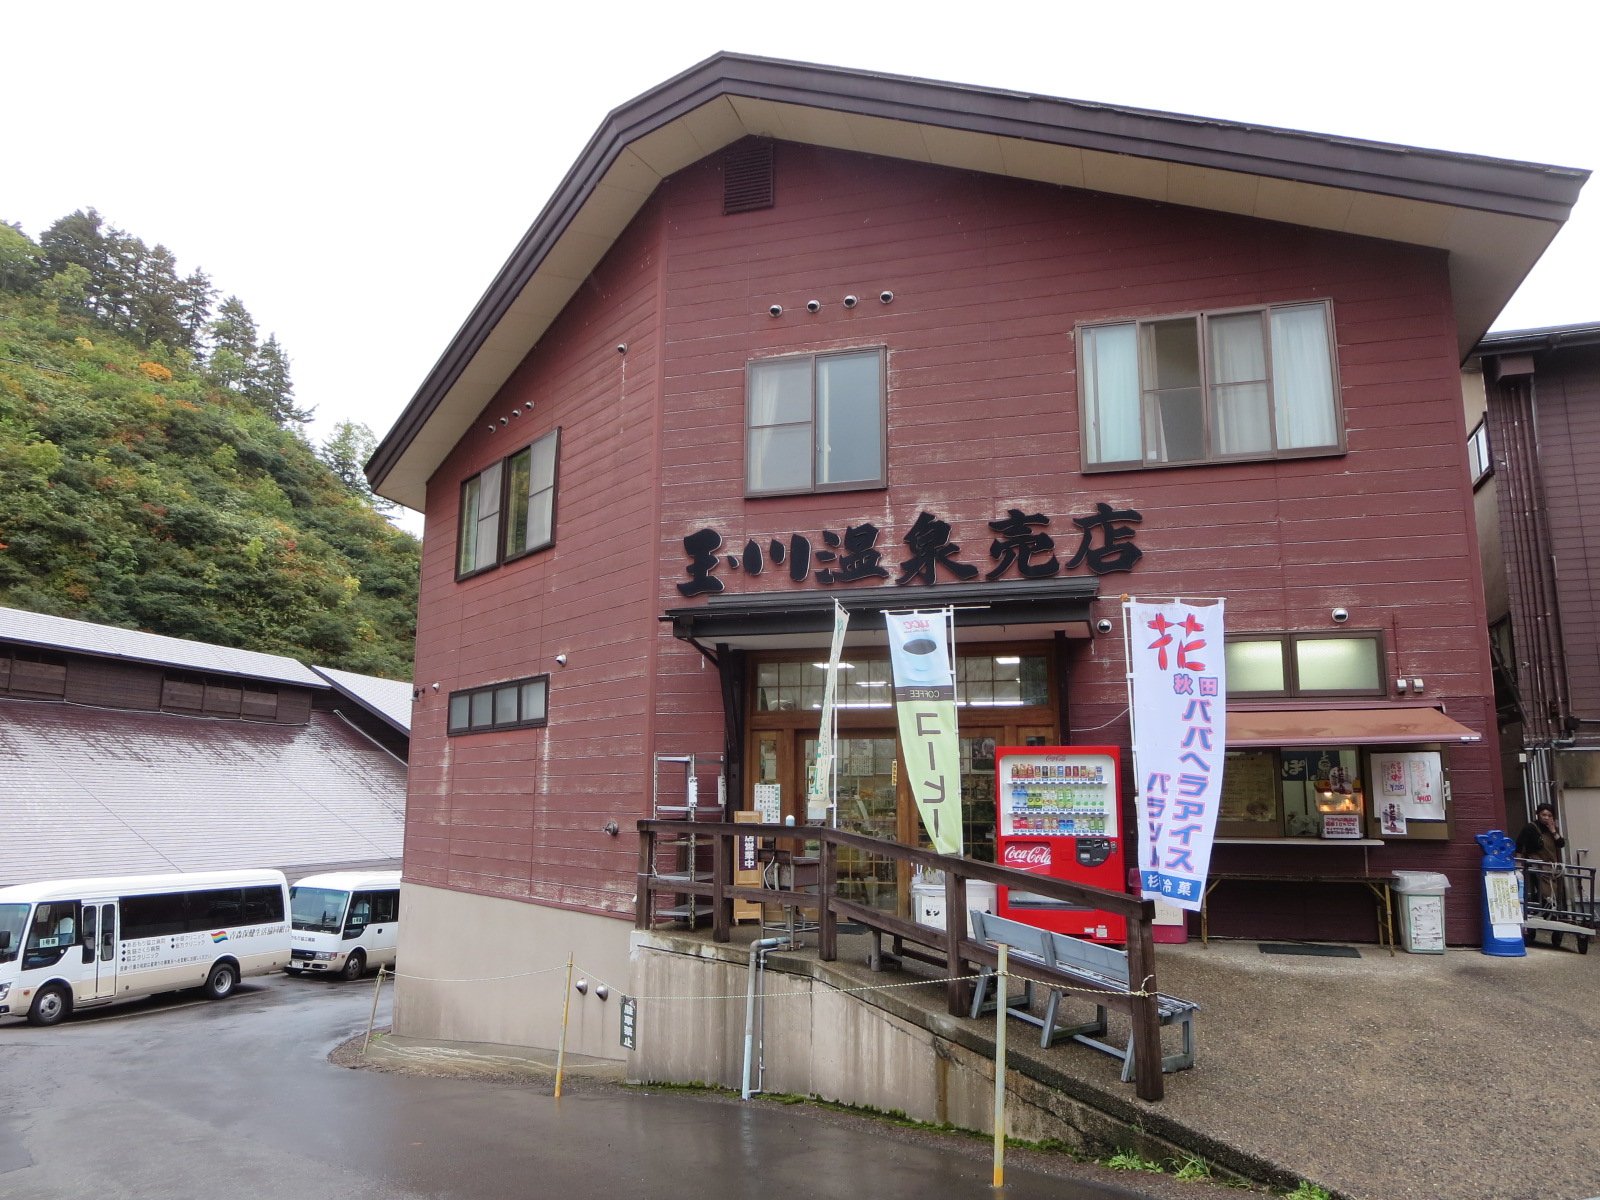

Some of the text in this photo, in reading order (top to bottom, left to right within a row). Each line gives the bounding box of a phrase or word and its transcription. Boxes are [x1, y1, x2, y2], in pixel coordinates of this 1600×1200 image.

[677, 503, 1143, 597] 玉川温泉売店
[1147, 613, 1206, 671] 花
[1173, 673, 1219, 696] 秋田
[1164, 698, 1214, 873] ババヘラアイス
[1004, 845, 1051, 864] Coca-Cola
